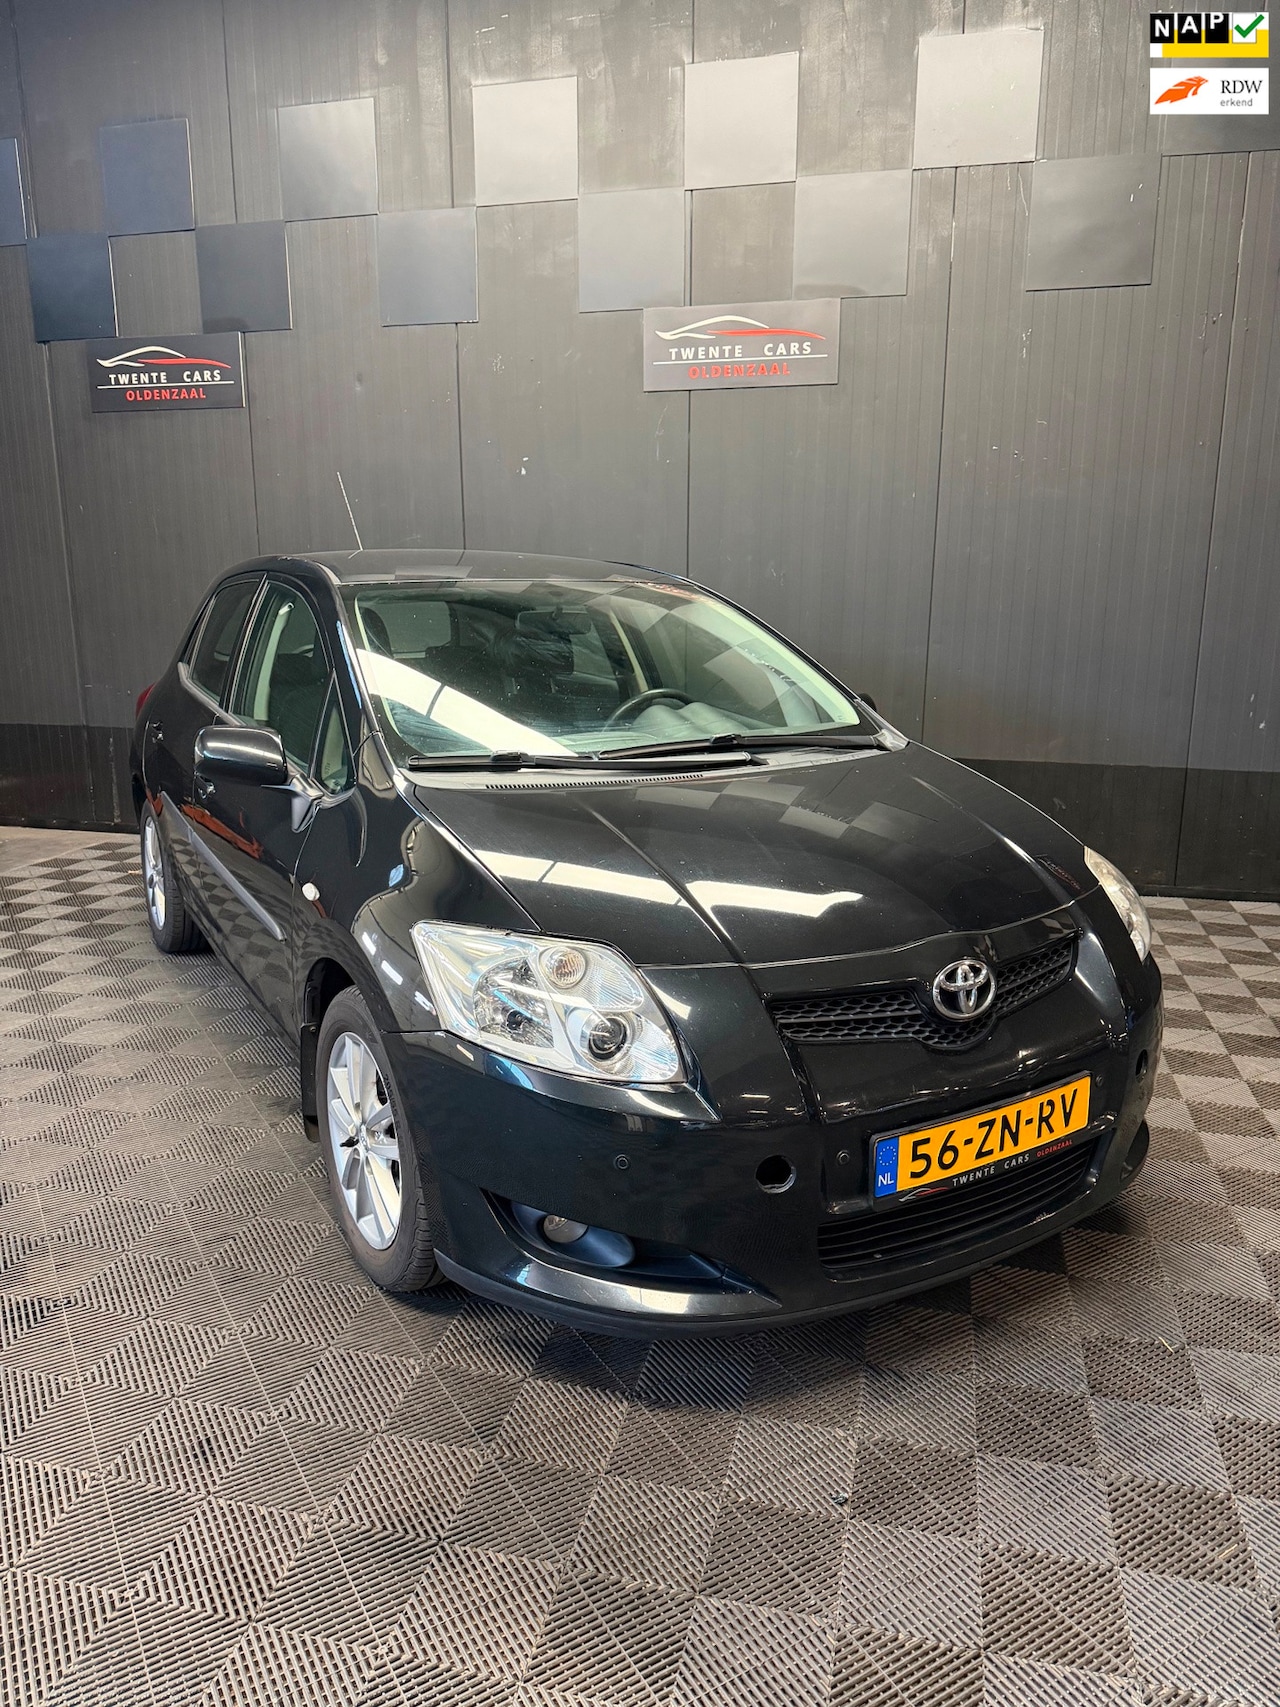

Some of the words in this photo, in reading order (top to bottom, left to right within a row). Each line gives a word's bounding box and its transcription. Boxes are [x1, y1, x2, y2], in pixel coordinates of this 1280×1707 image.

[669, 345, 743, 361] TWENTE
[763, 341, 812, 356] CARS
[109, 372, 168, 385] TWENTE
[183, 370, 221, 382] CARS
[688, 362, 790, 379] OLDENZAAL
[126, 387, 206, 401] OLDENZAAL
[877, 1172, 895, 1187] NL
[910, 1088, 1078, 1179] 56-ZN-RV
[952, 1165, 996, 1187] TWENTE
[1004, 1153, 1030, 1170] CARS
[1036, 1139, 1073, 1158] OLDENZAAL
